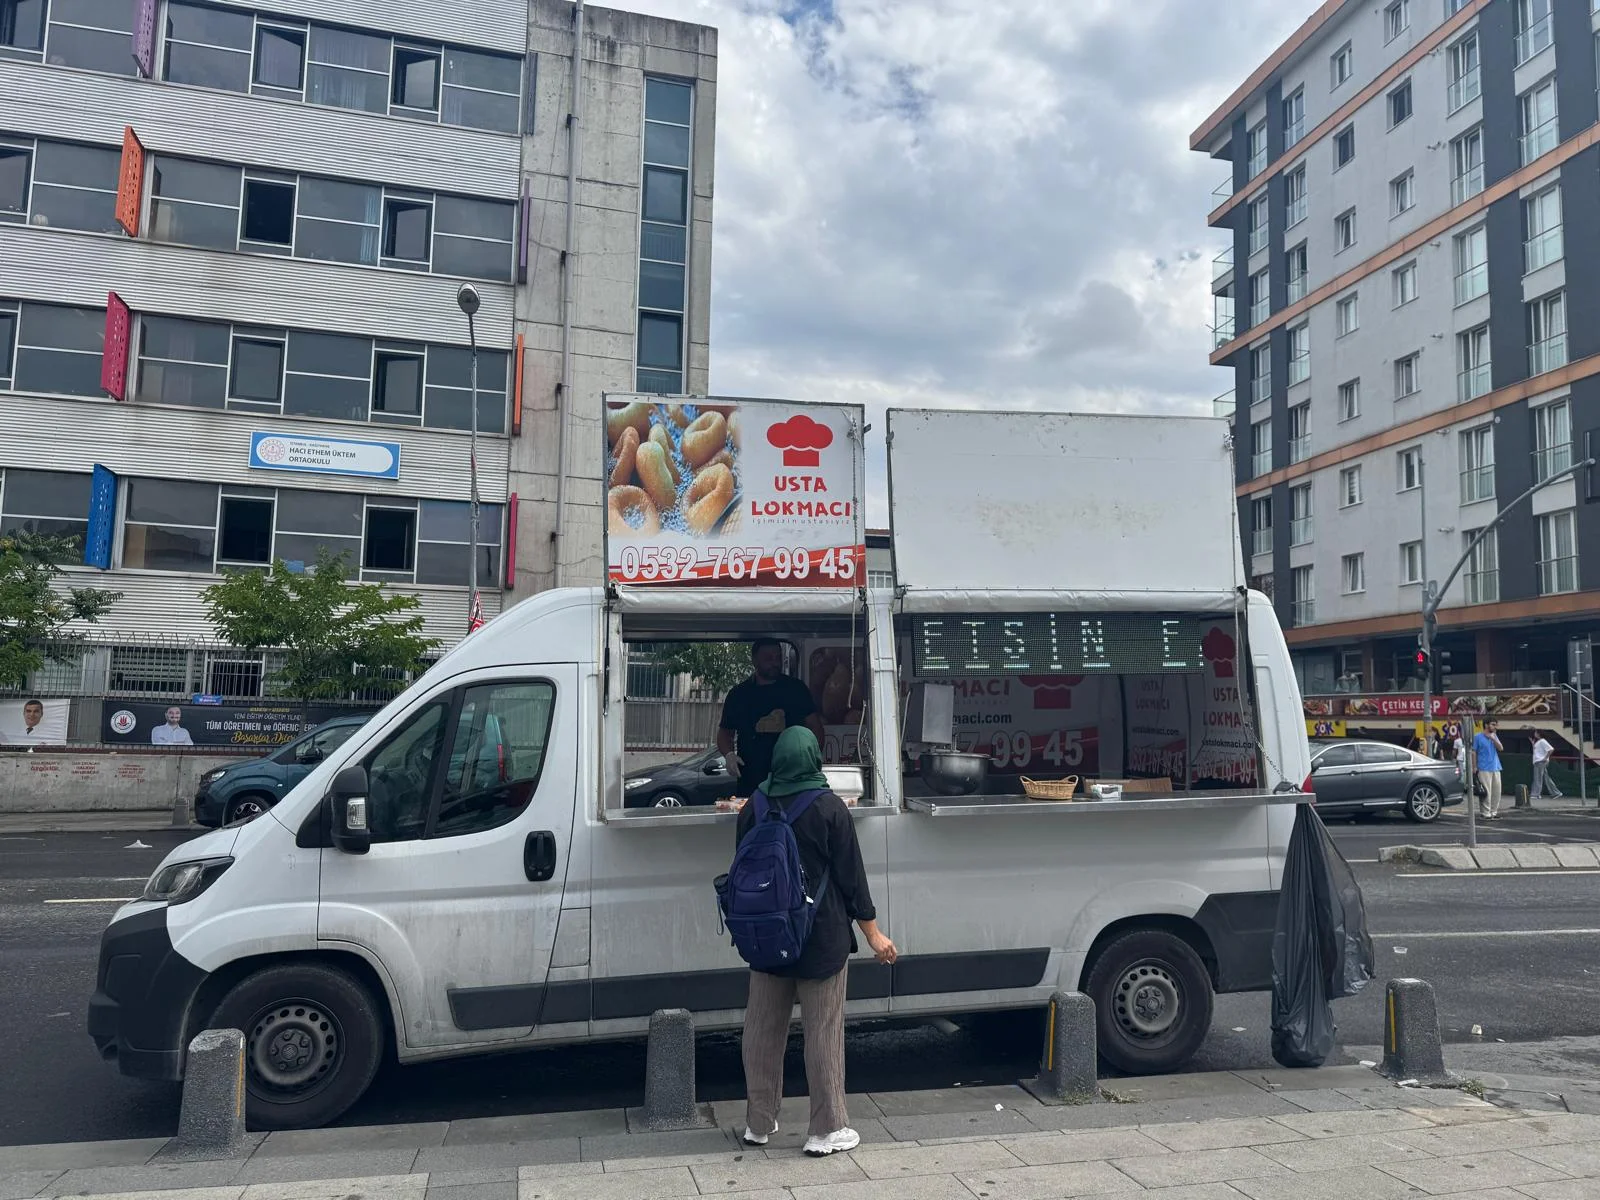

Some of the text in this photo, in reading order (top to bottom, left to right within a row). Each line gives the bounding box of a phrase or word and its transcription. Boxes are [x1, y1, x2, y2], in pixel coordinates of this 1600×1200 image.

[289, 456, 331, 465] ORTAOKULU
[332, 450, 356, 458] ÜKTEM
[774, 476, 828, 492] USTA
[751, 500, 851, 517] LOKMACI
[620, 546, 855, 580] 0532 767 99 45
[1213, 686, 1240, 702] USTA
[1382, 699, 1407, 715] ÇETİN
[206, 720, 222, 730] TÜM
[223, 720, 261, 731] ÖĞRETMEN
[991, 730, 1033, 768] 99
[1043, 729, 1083, 767] 45
